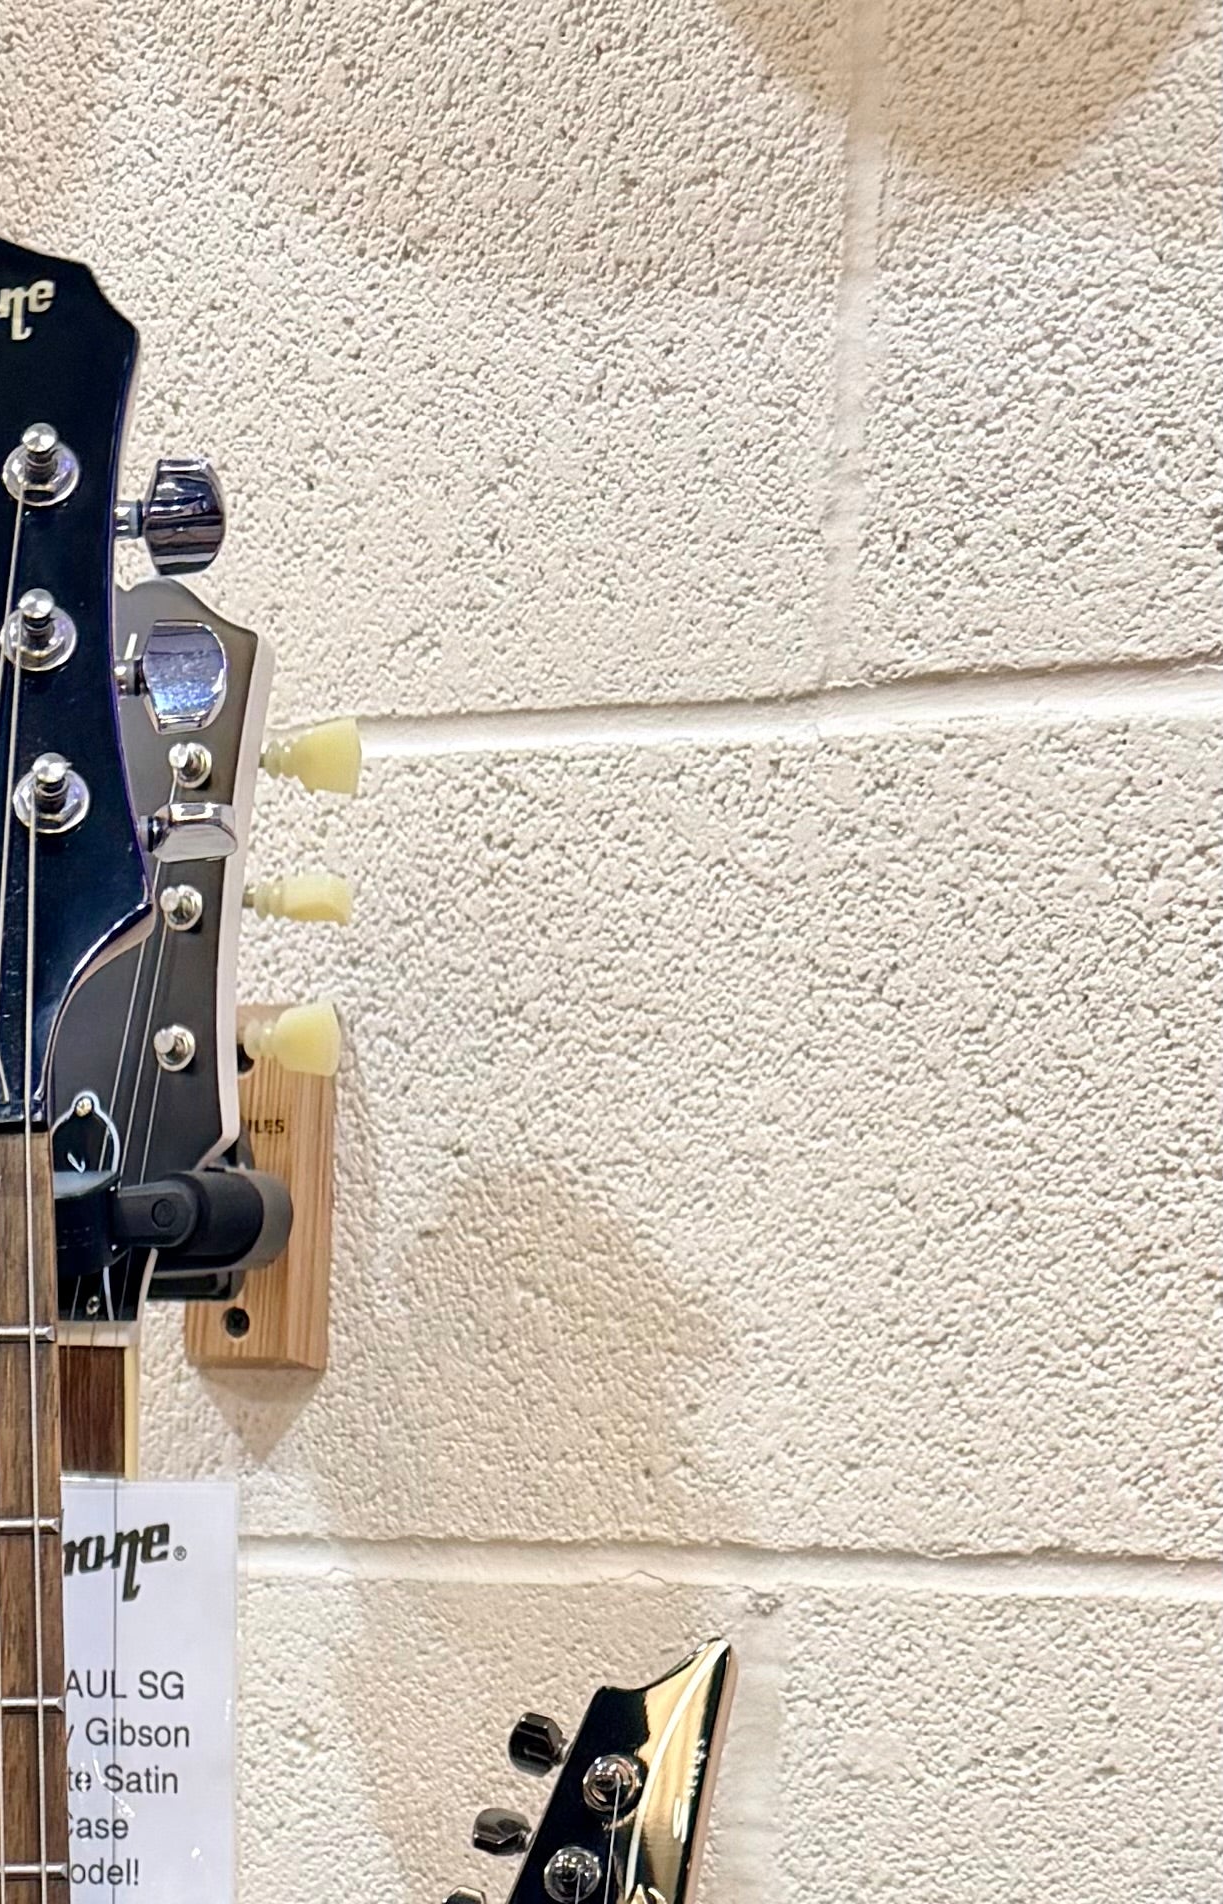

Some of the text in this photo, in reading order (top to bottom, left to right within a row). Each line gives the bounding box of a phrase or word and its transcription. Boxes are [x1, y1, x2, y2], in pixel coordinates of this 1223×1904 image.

[66, 1668, 185, 1701] AUL SG
[85, 1717, 190, 1749] Gibson
[104, 1763, 179, 1794] Satin
[71, 1857, 140, 1887] odel!
